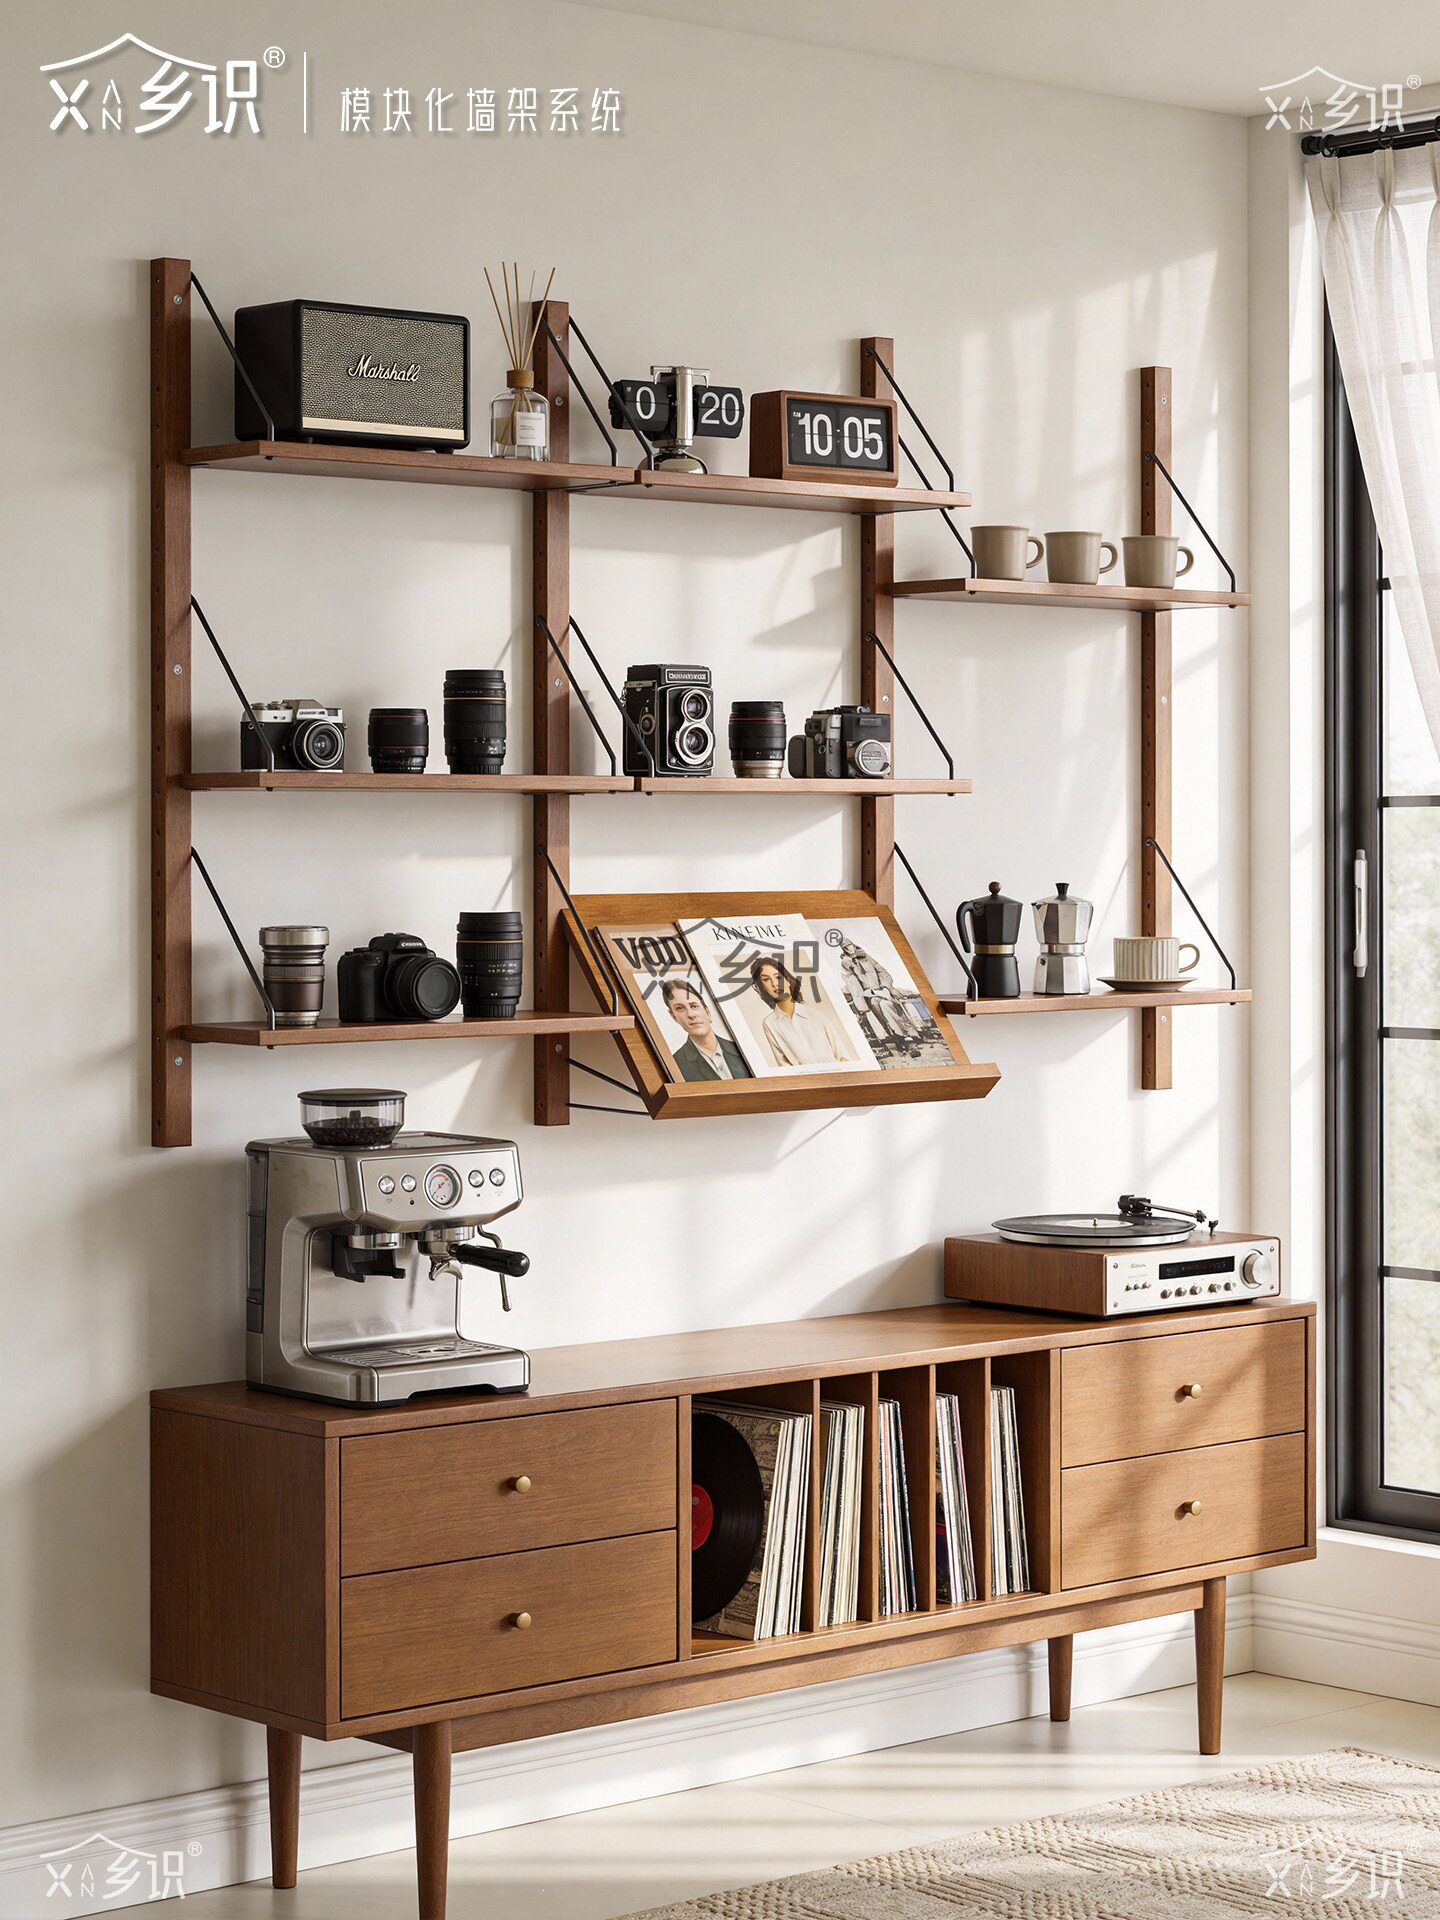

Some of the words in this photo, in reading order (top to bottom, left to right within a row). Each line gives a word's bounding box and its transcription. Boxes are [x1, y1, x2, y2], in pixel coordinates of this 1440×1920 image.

[348, 354, 421, 383] Marshall
[700, 391, 740, 426] 20
[798, 412, 884, 460] 10:05
